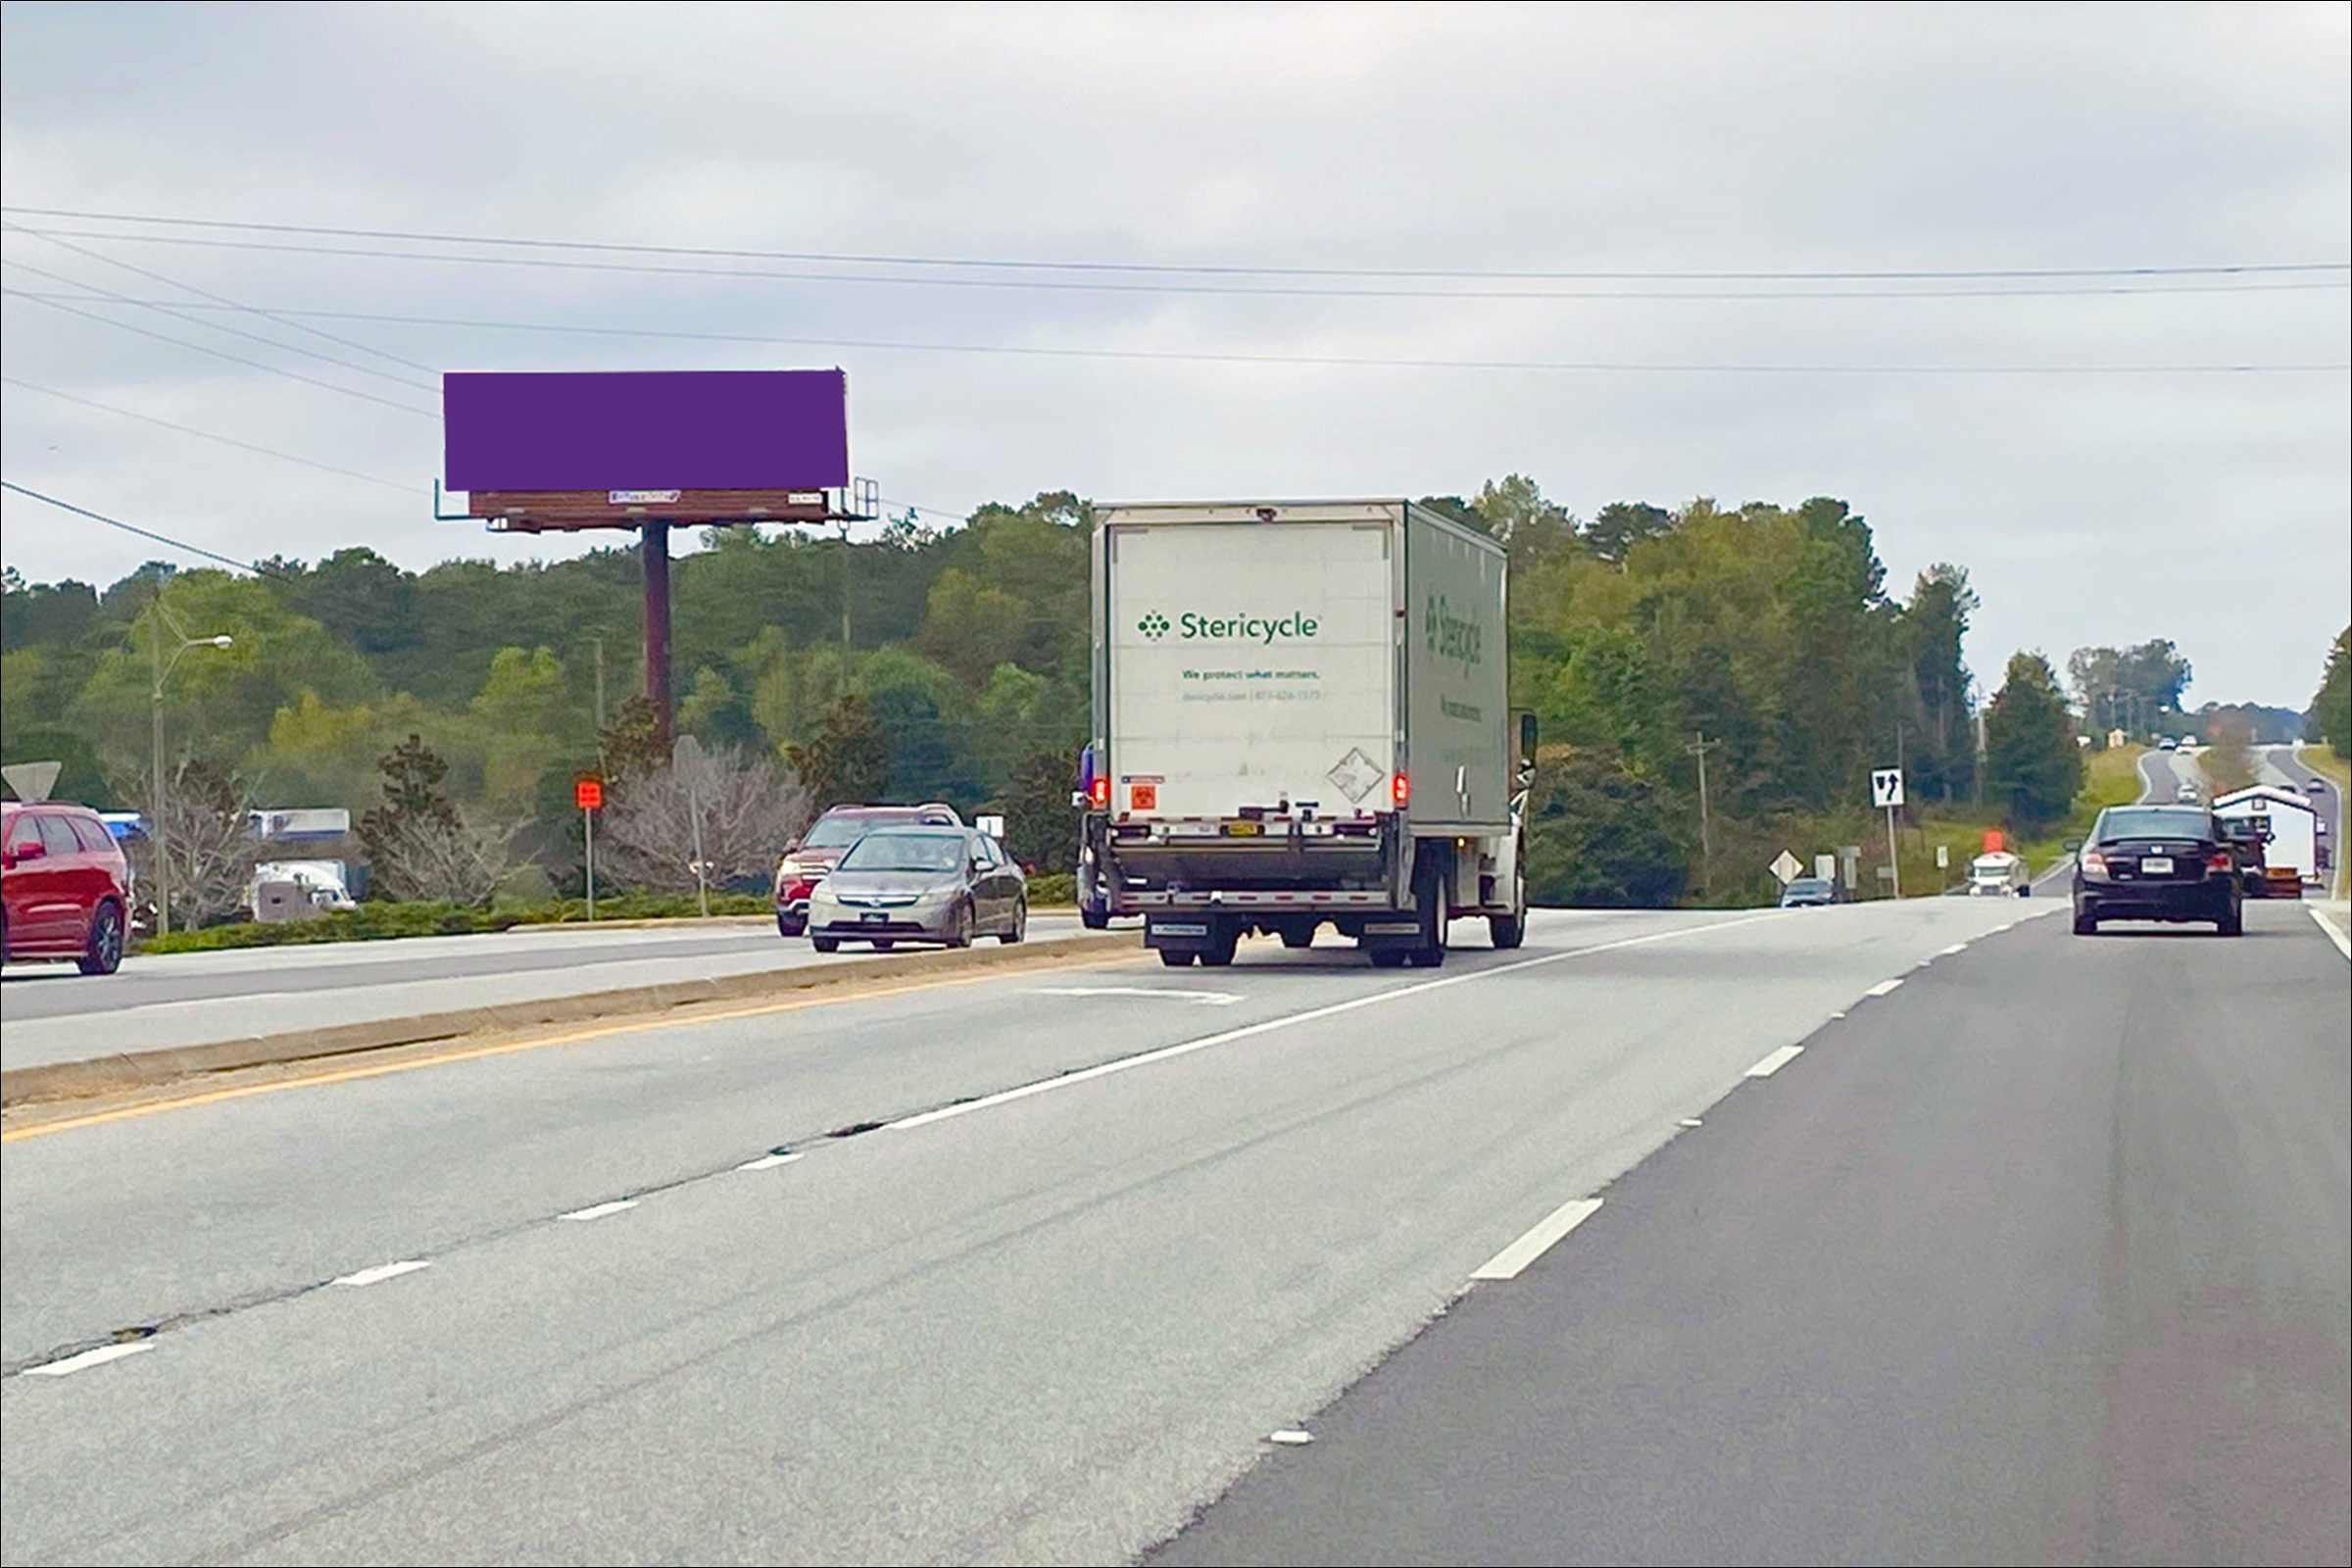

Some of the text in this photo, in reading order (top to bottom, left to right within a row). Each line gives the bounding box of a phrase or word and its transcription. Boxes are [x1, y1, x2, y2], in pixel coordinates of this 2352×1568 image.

[1181, 611, 1318, 645] Stericycle
[1182, 669, 1200, 679] We
[1202, 669, 1244, 682] protect
[1246, 668, 1273, 679] what
